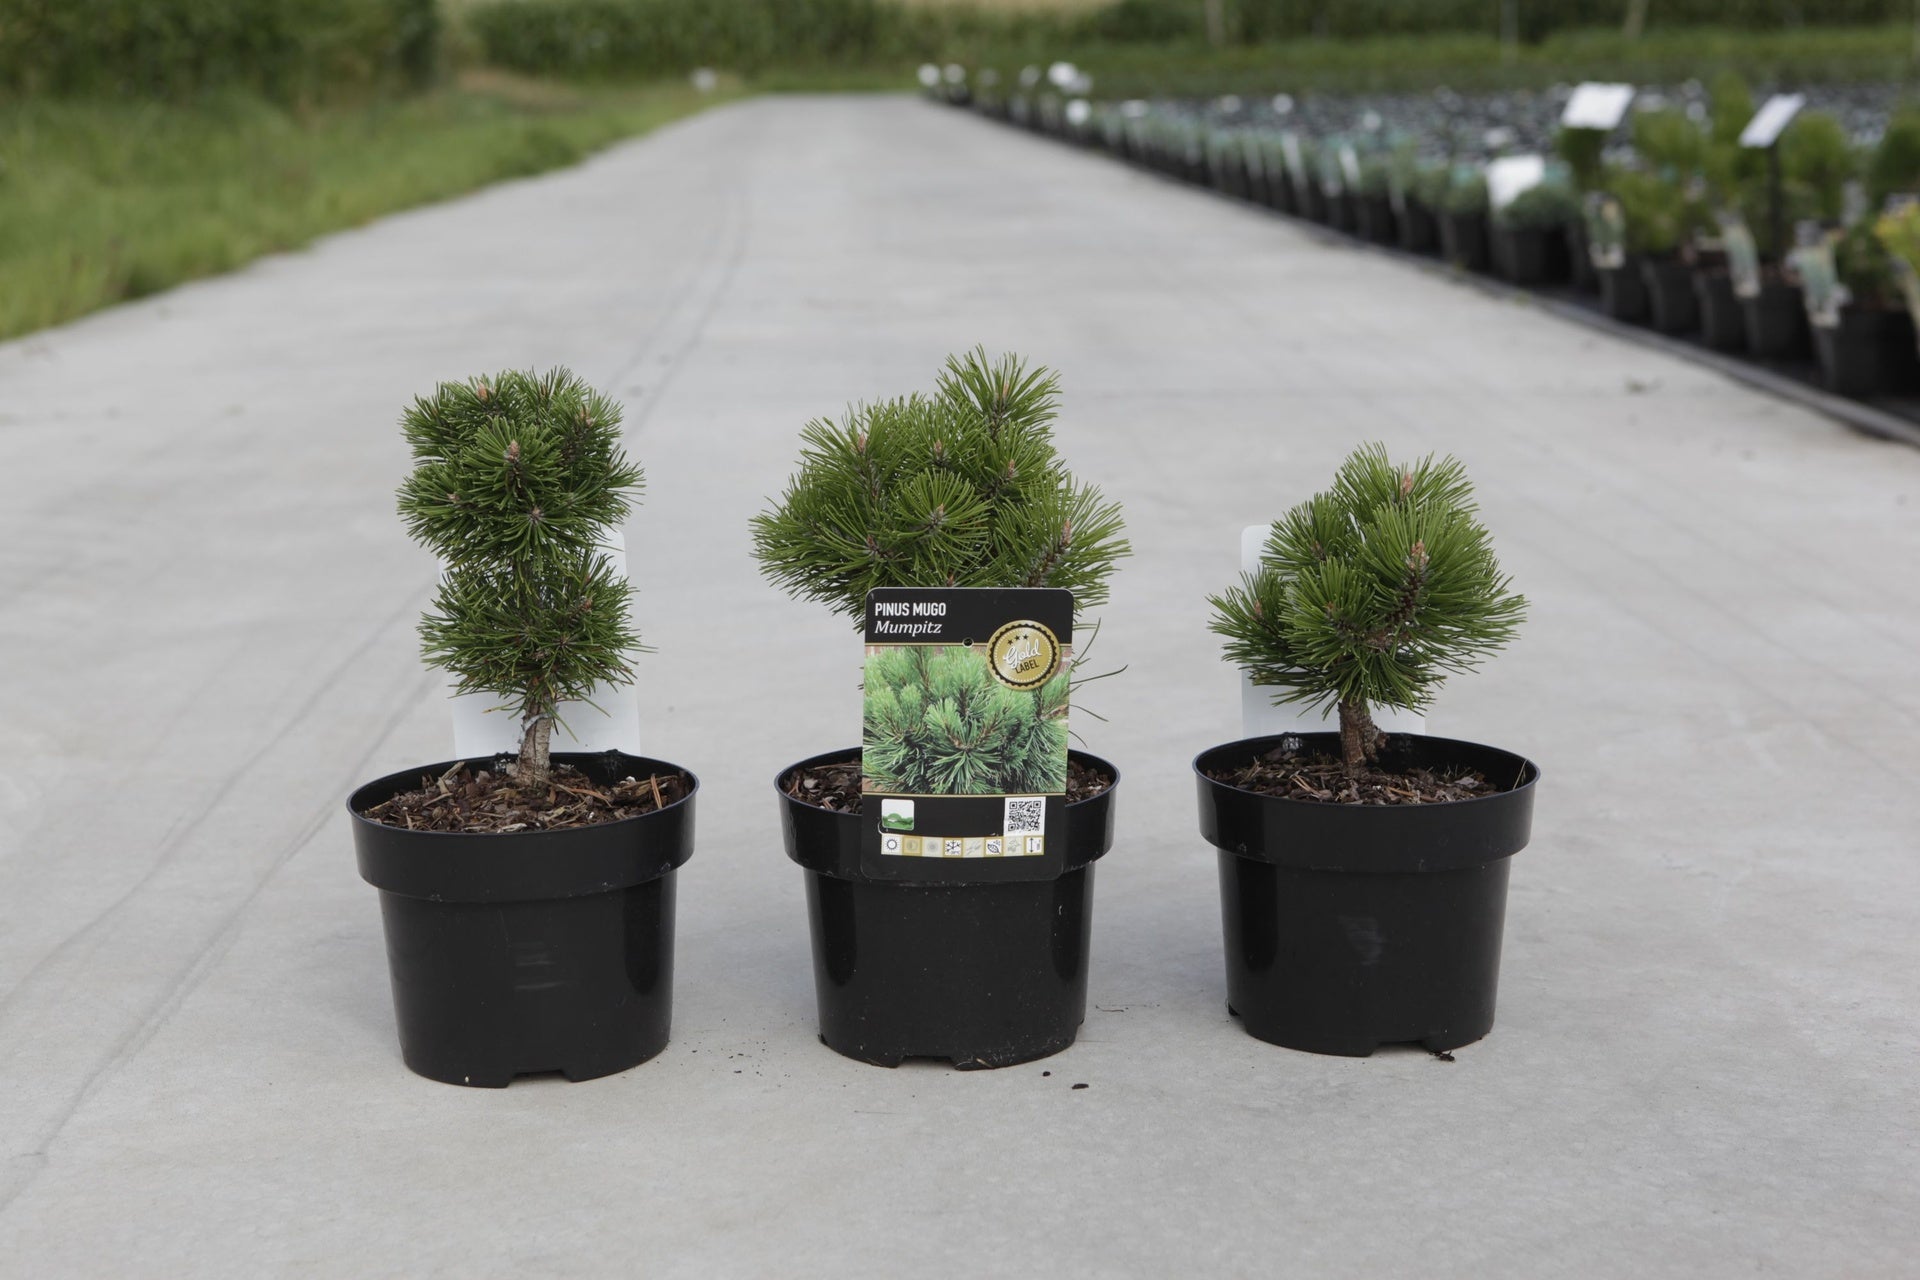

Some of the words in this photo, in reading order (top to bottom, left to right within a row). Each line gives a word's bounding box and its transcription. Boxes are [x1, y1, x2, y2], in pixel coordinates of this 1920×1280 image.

[875, 602, 910, 616] PINUS
[912, 602, 947, 616] MUGO
[874, 620, 943, 637] Mumpitz
[1003, 638, 1042, 669] Gold
[1015, 659, 1040, 674] LABEL
